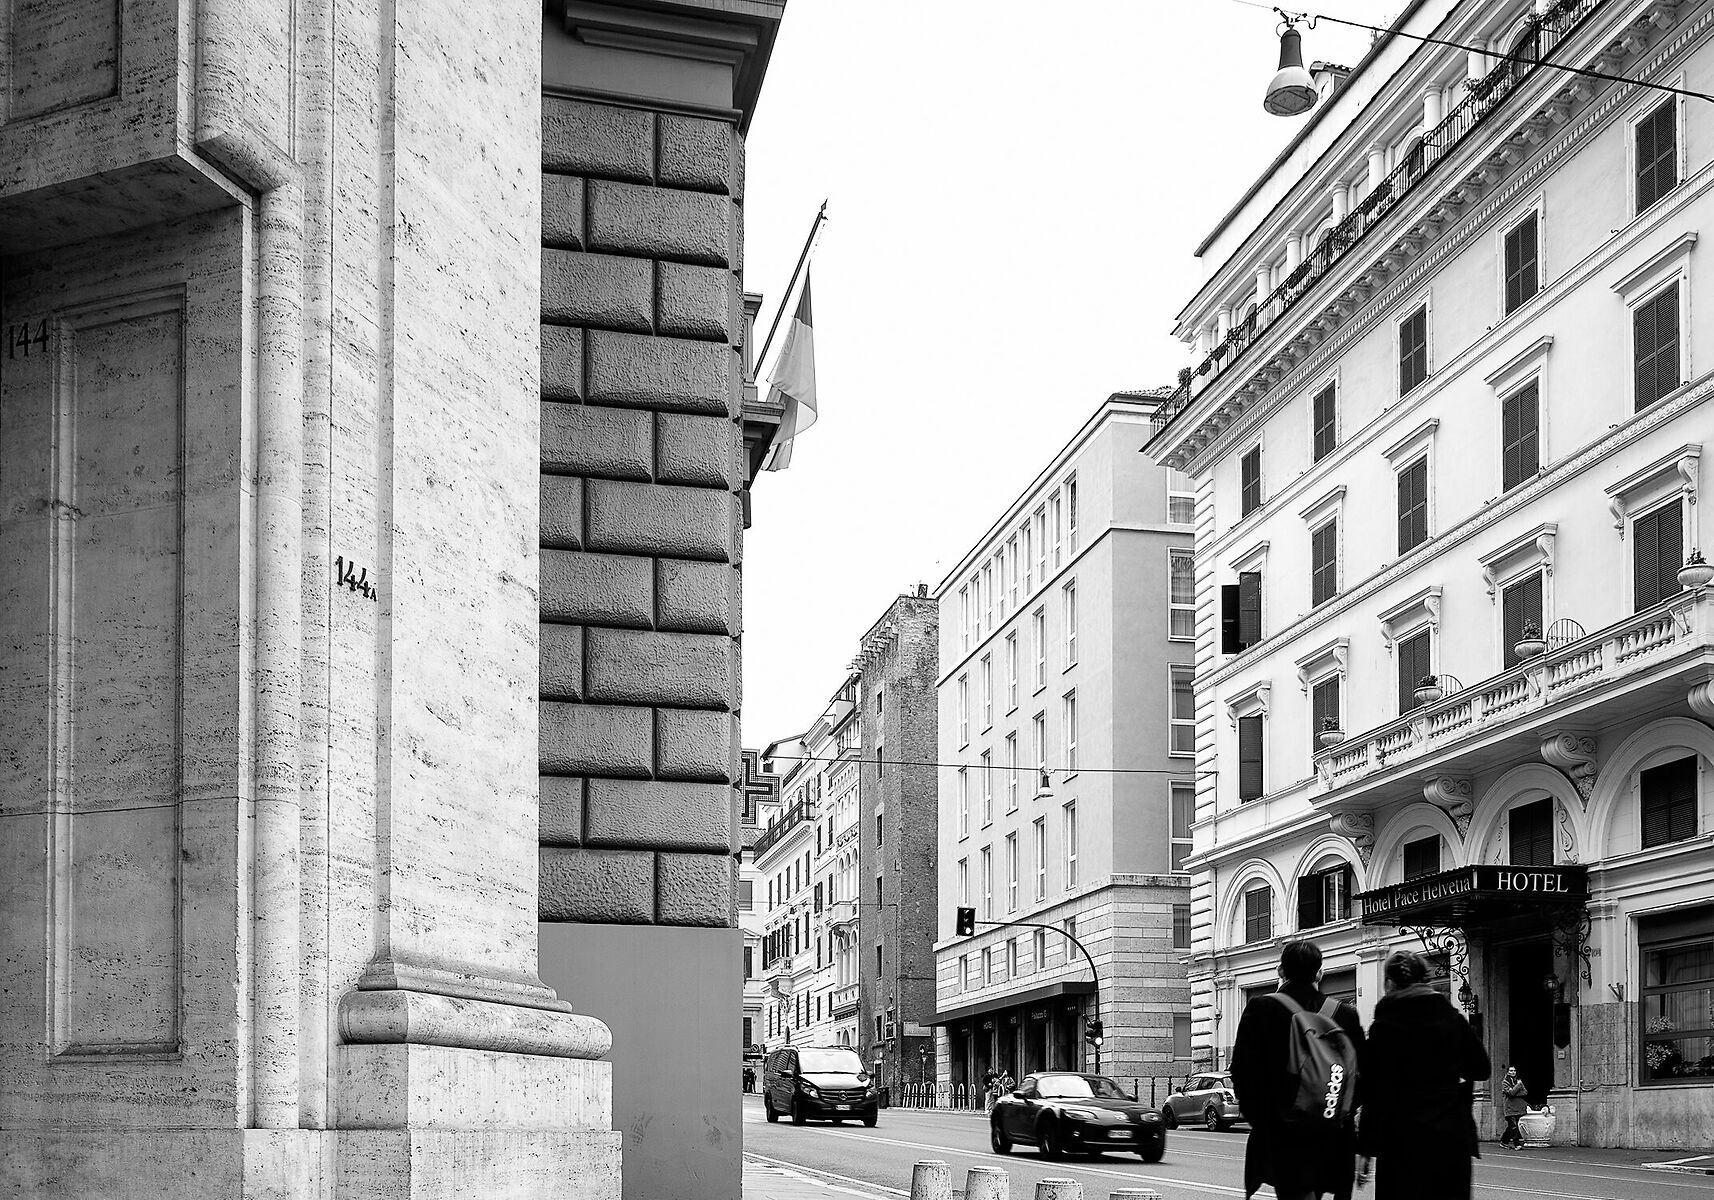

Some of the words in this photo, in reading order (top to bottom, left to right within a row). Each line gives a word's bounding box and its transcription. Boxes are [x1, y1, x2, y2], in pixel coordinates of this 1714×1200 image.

[8, 319, 50, 360] 144
[1497, 871, 1569, 892] HOTEL
[1364, 893, 1391, 914] Hotel
[1394, 889, 1419, 908] Pace
[1323, 1063, 1344, 1118] adidas
